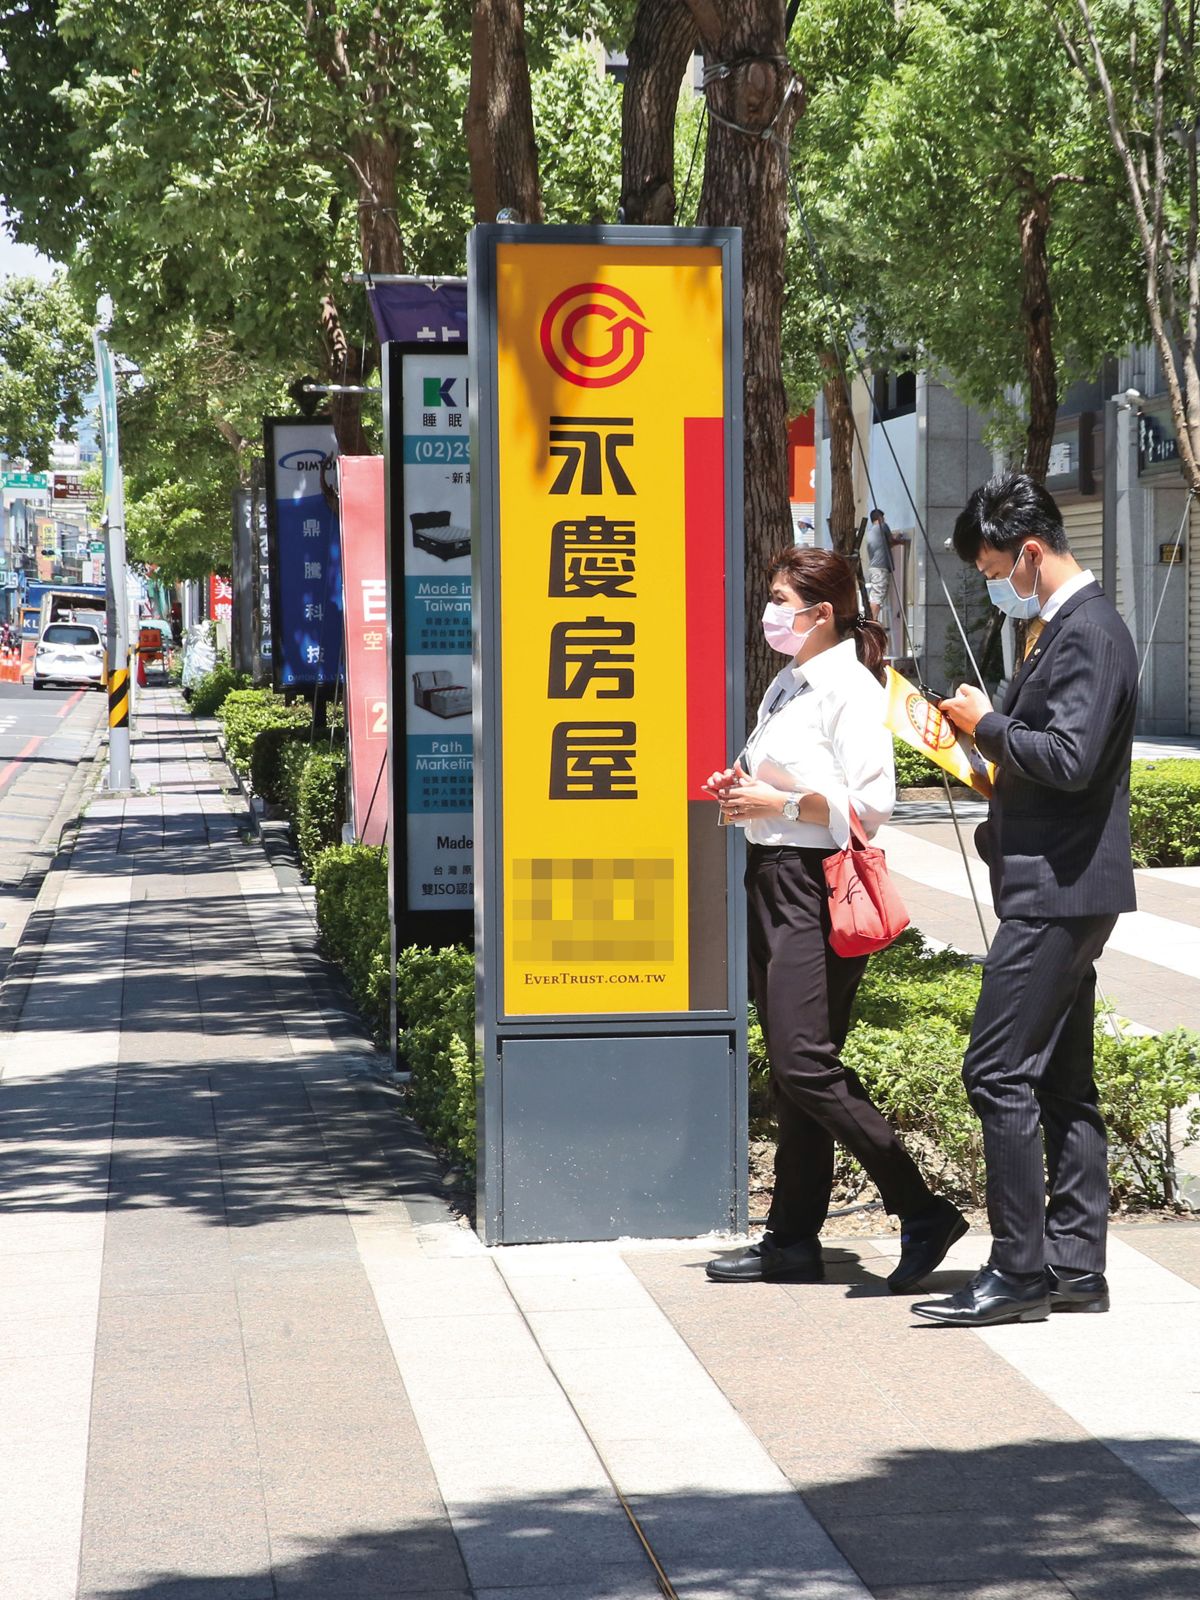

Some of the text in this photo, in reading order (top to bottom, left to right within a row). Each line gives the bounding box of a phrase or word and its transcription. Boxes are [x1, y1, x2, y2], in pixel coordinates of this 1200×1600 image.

[423, 413, 462, 427] 睡眠
[303, 519, 325, 663] 鼎騰科技
[418, 583, 457, 594] Made
[424, 600, 471, 611] Taiwan
[548, 416, 638, 800] 永慶房屋
[432, 741, 462, 753] Path
[437, 835, 473, 849] Made
